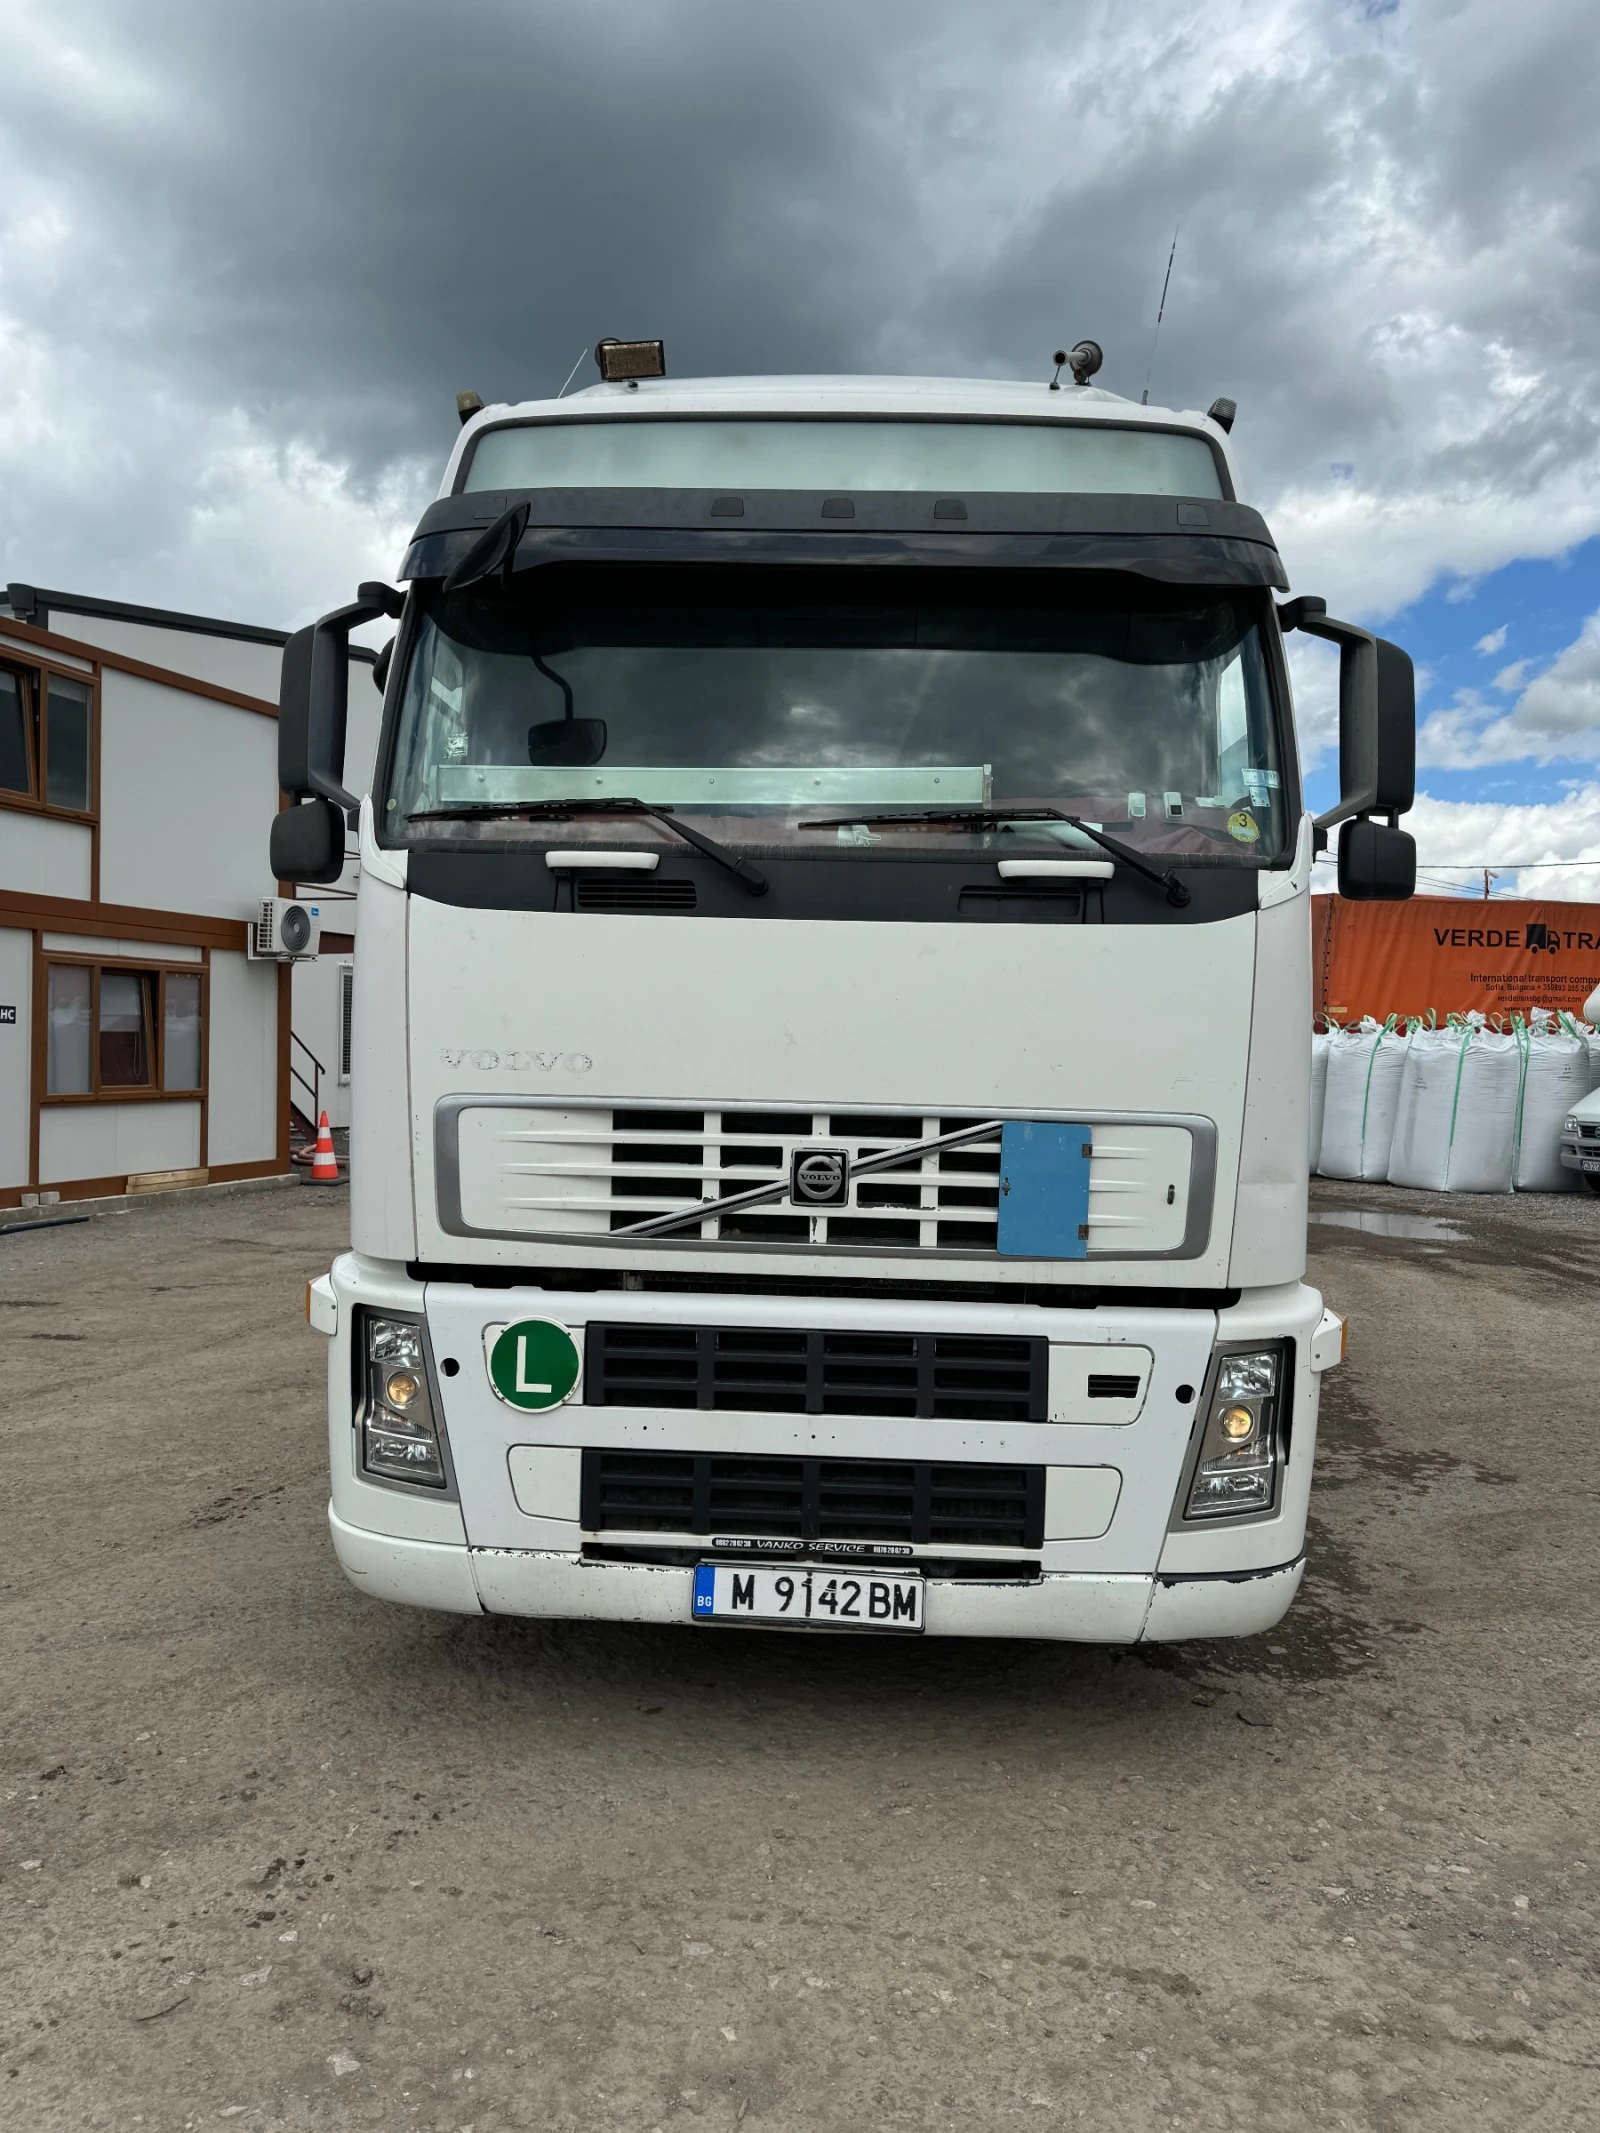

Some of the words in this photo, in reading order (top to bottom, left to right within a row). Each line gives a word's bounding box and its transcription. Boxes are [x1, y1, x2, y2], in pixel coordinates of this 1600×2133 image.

[1238, 813, 1248, 828] 3
[1433, 928, 1521, 948] VERDE
[1470, 973, 1527, 983] International
[1528, 973, 1568, 985] transport
[440, 1048, 594, 1073] VOLVO
[799, 1173, 840, 1181] VOLVO
[516, 1335, 552, 1393] L
[756, 1540, 804, 1550] VANKO
[808, 1542, 866, 1553] SERVICE
[697, 1596, 712, 1607] BG
[731, 1574, 755, 1610] M
[774, 1576, 861, 1617] 9142
